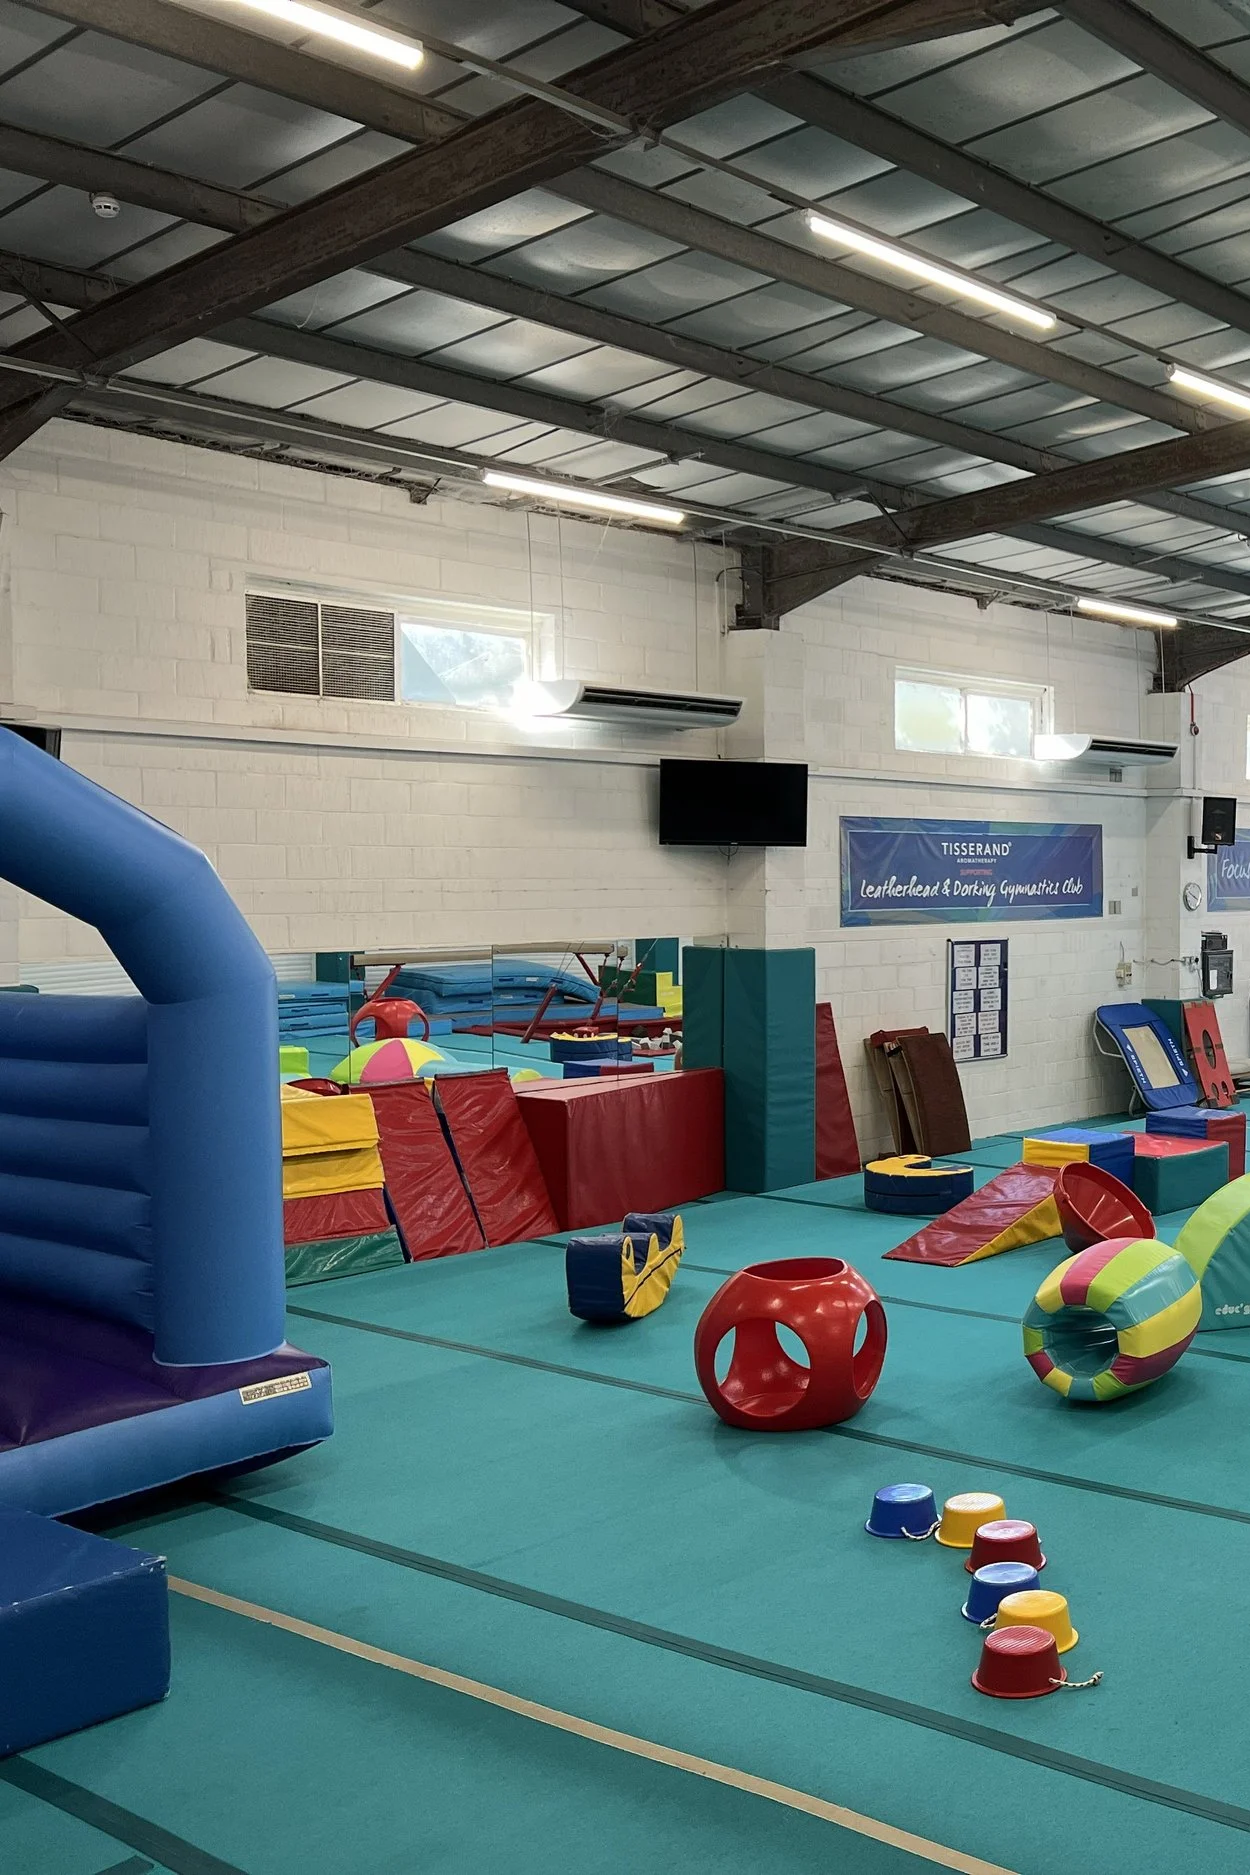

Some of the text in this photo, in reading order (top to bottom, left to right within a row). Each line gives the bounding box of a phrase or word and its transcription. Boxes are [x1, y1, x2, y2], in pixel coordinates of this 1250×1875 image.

[1221, 857, 1250, 880] Focus
[860, 875, 1084, 908] Leatherhead & Dorking Gymnastics Club
